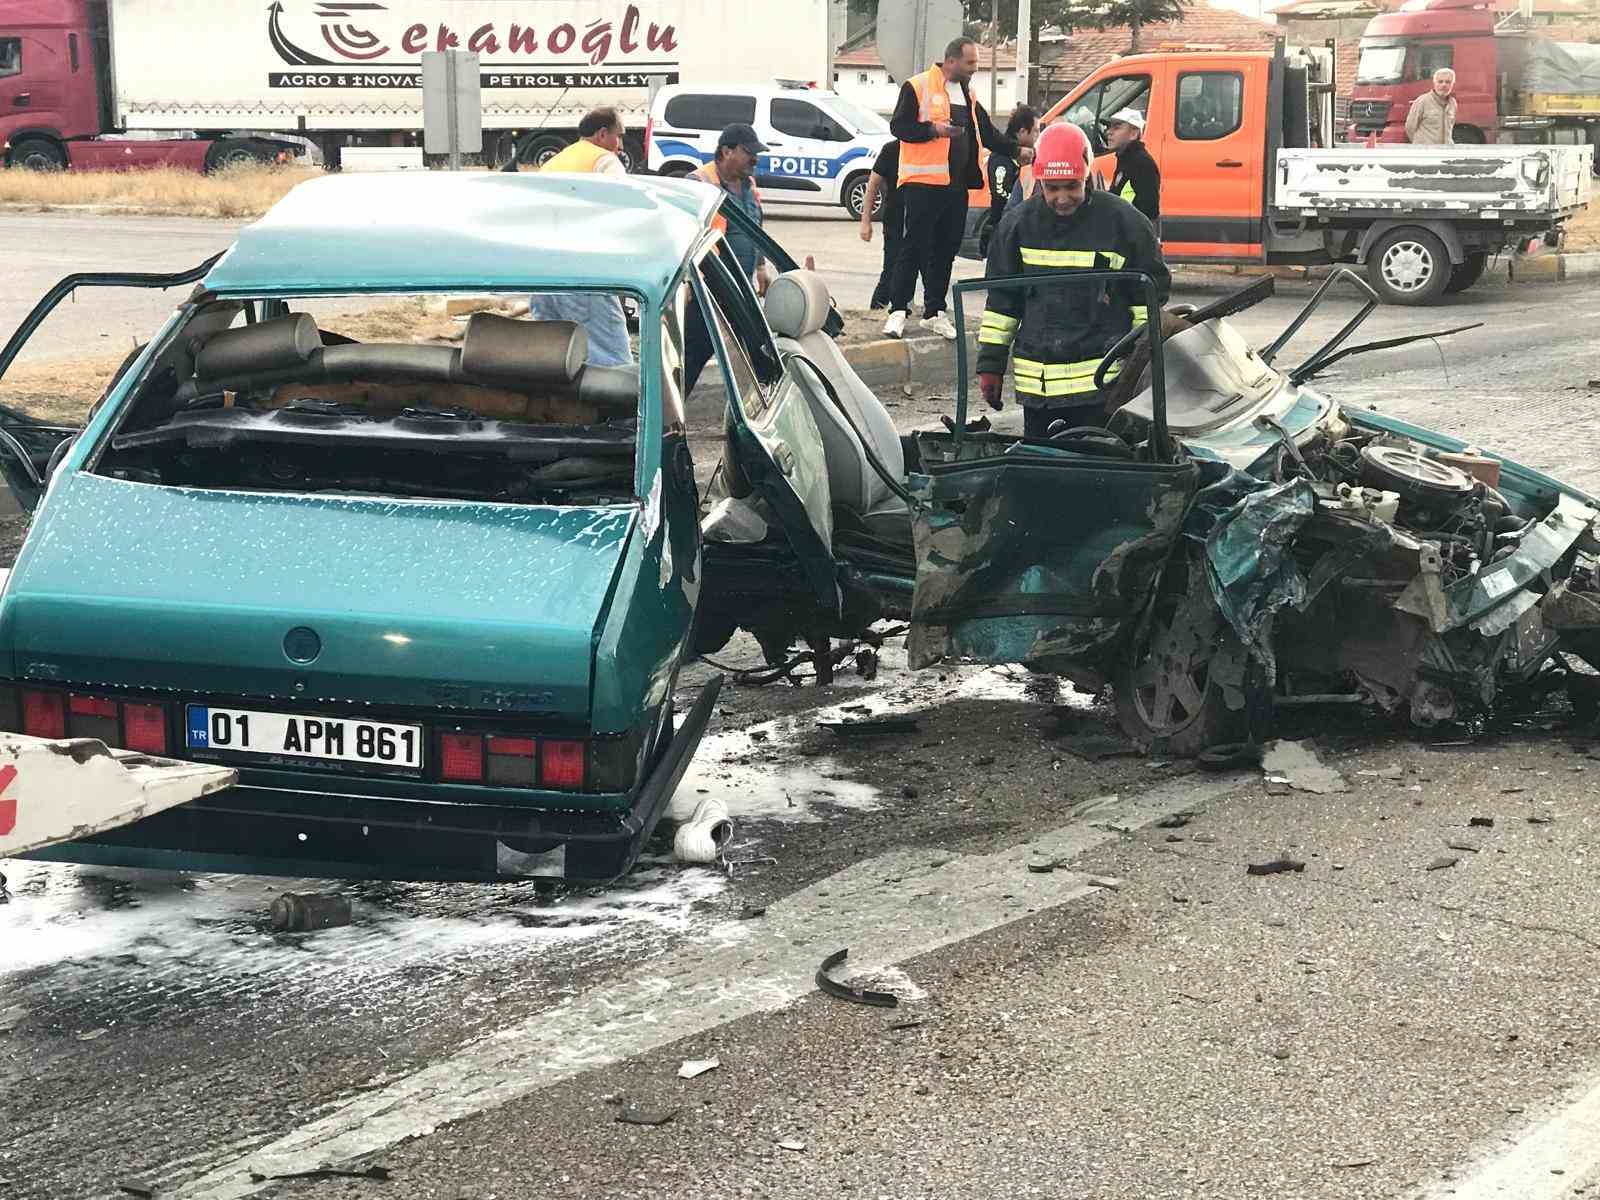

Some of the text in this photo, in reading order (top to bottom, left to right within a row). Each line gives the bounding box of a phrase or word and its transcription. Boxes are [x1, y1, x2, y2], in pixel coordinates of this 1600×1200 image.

[279, 74, 668, 87] AGRO & İNOVAS PETROL & NAKLİY
[191, 728, 208, 740] TR
[211, 712, 415, 764] 01 APM 861
